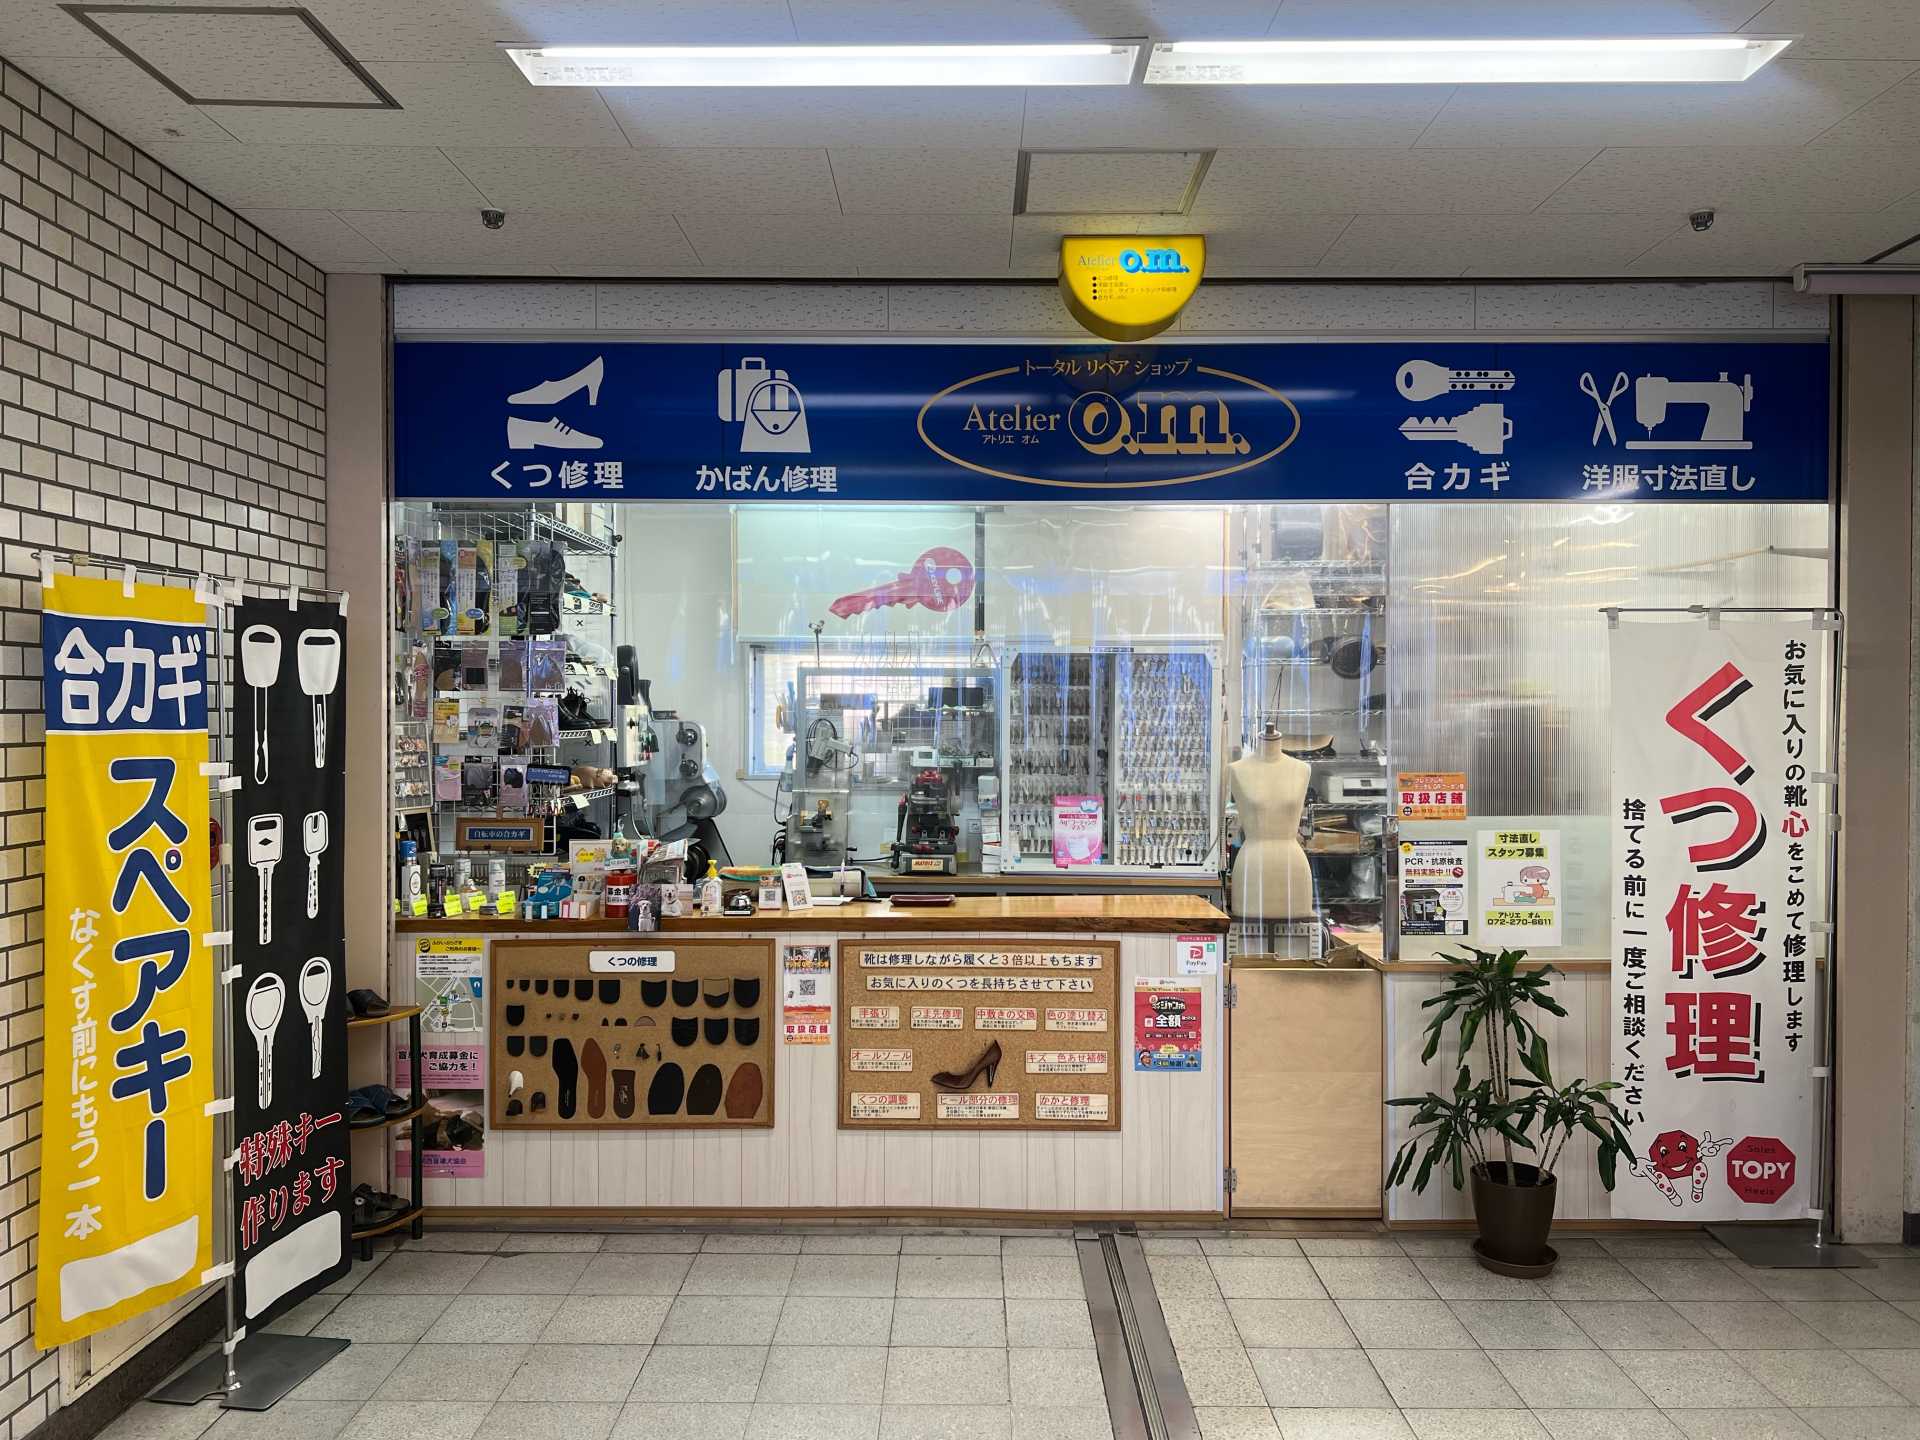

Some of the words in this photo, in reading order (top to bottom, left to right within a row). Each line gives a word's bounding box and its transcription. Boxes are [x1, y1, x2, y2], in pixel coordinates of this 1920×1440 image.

[1023, 360, 1080, 376] トータル
[1087, 359, 1129, 376] リペア
[1135, 358, 1193, 376] ショップ
[963, 402, 1060, 432] Atelier
[983, 435, 1014, 445] アトリエ
[1022, 435, 1040, 445] オム
[490, 460, 624, 490] くつ修理
[696, 464, 837, 492] かばん修理
[1405, 461, 1511, 491] 合カギ
[1582, 464, 1756, 491] 洋服寸法直し
[54, 626, 202, 726] 合カギ
[1402, 792, 1463, 804] 取扱店舗
[1488, 848, 1544, 857] スタッフ募集
[1499, 834, 1537, 844] 寸法直し
[1781, 640, 1810, 1052] お気に入りの靴心をこめて修理します
[1405, 857, 1463, 865] PCR・抗原検査
[1659, 660, 1768, 1084] くつ修理
[608, 956, 658, 967] くつの修理
[864, 953, 1099, 967] 靴は修理しながら履くと3倍以上もちます
[1622, 798, 1648, 1125] 捨てる前に一度ご相談ください
[108, 757, 193, 1200] スペアキー
[871, 977, 1092, 990] お気に入りのくつを長持ちさせて下さい
[1156, 1014, 1182, 1027] 全額
[64, 907, 102, 1240] なくす前にもう一本
[239, 1111, 342, 1186] 特殊キー
[1731, 1160, 1792, 1179] TOPY
[239, 1156, 345, 1250] 作ります
